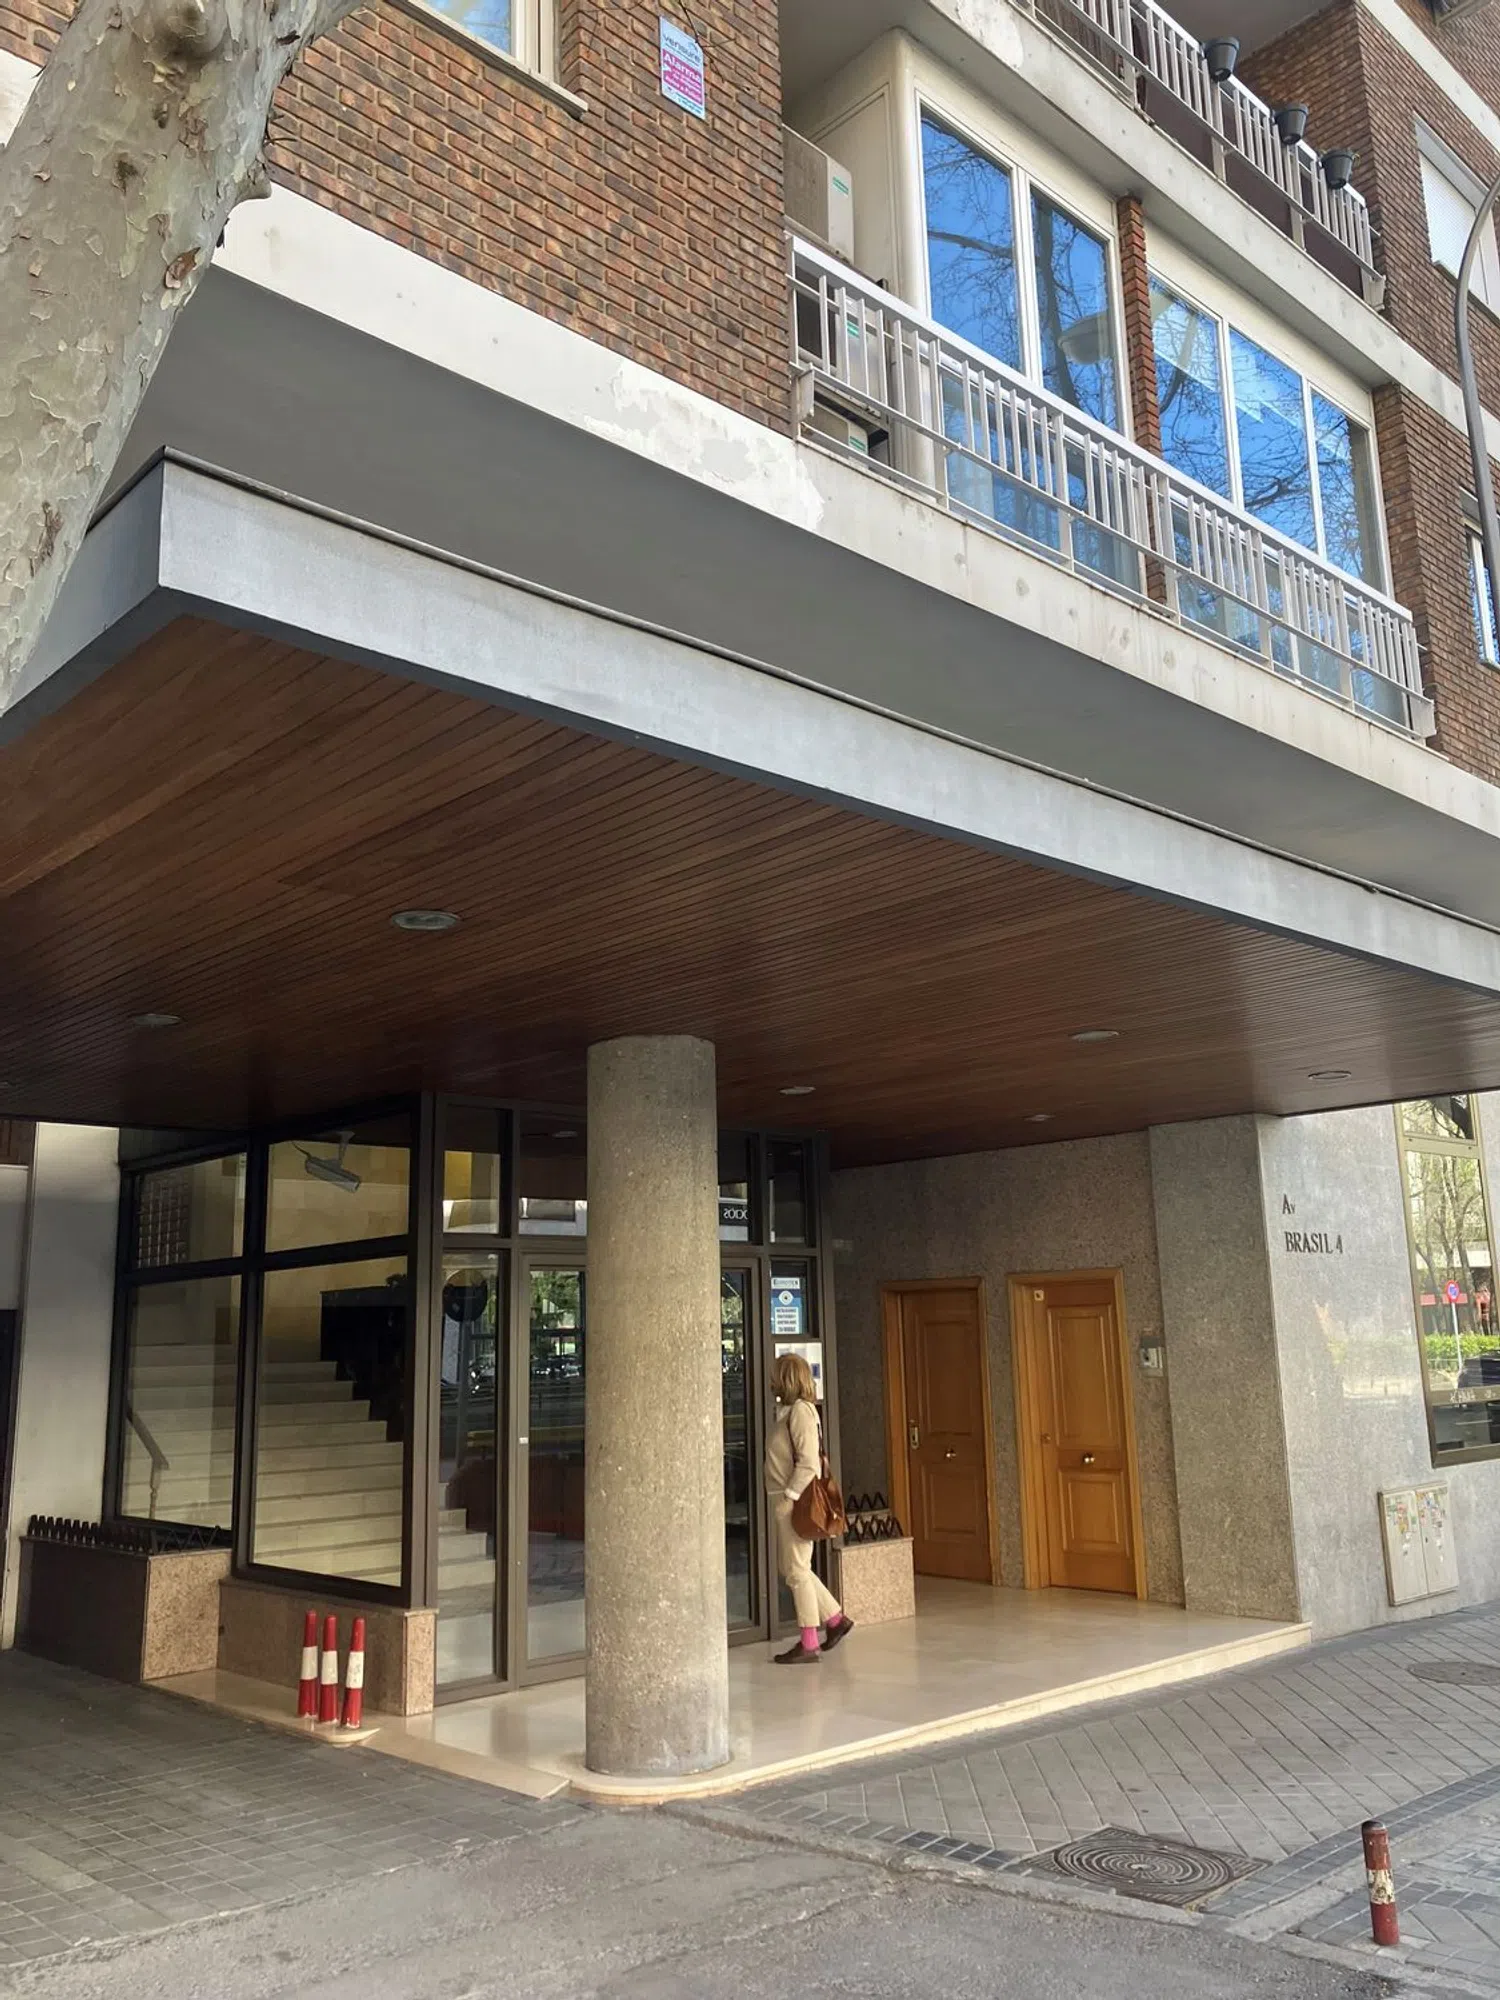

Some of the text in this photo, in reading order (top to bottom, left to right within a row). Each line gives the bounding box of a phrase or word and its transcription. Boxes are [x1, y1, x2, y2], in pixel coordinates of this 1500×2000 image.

[664, 53, 701, 81] Alarma
[1284, 1231, 1343, 1254] BRASIL 4
